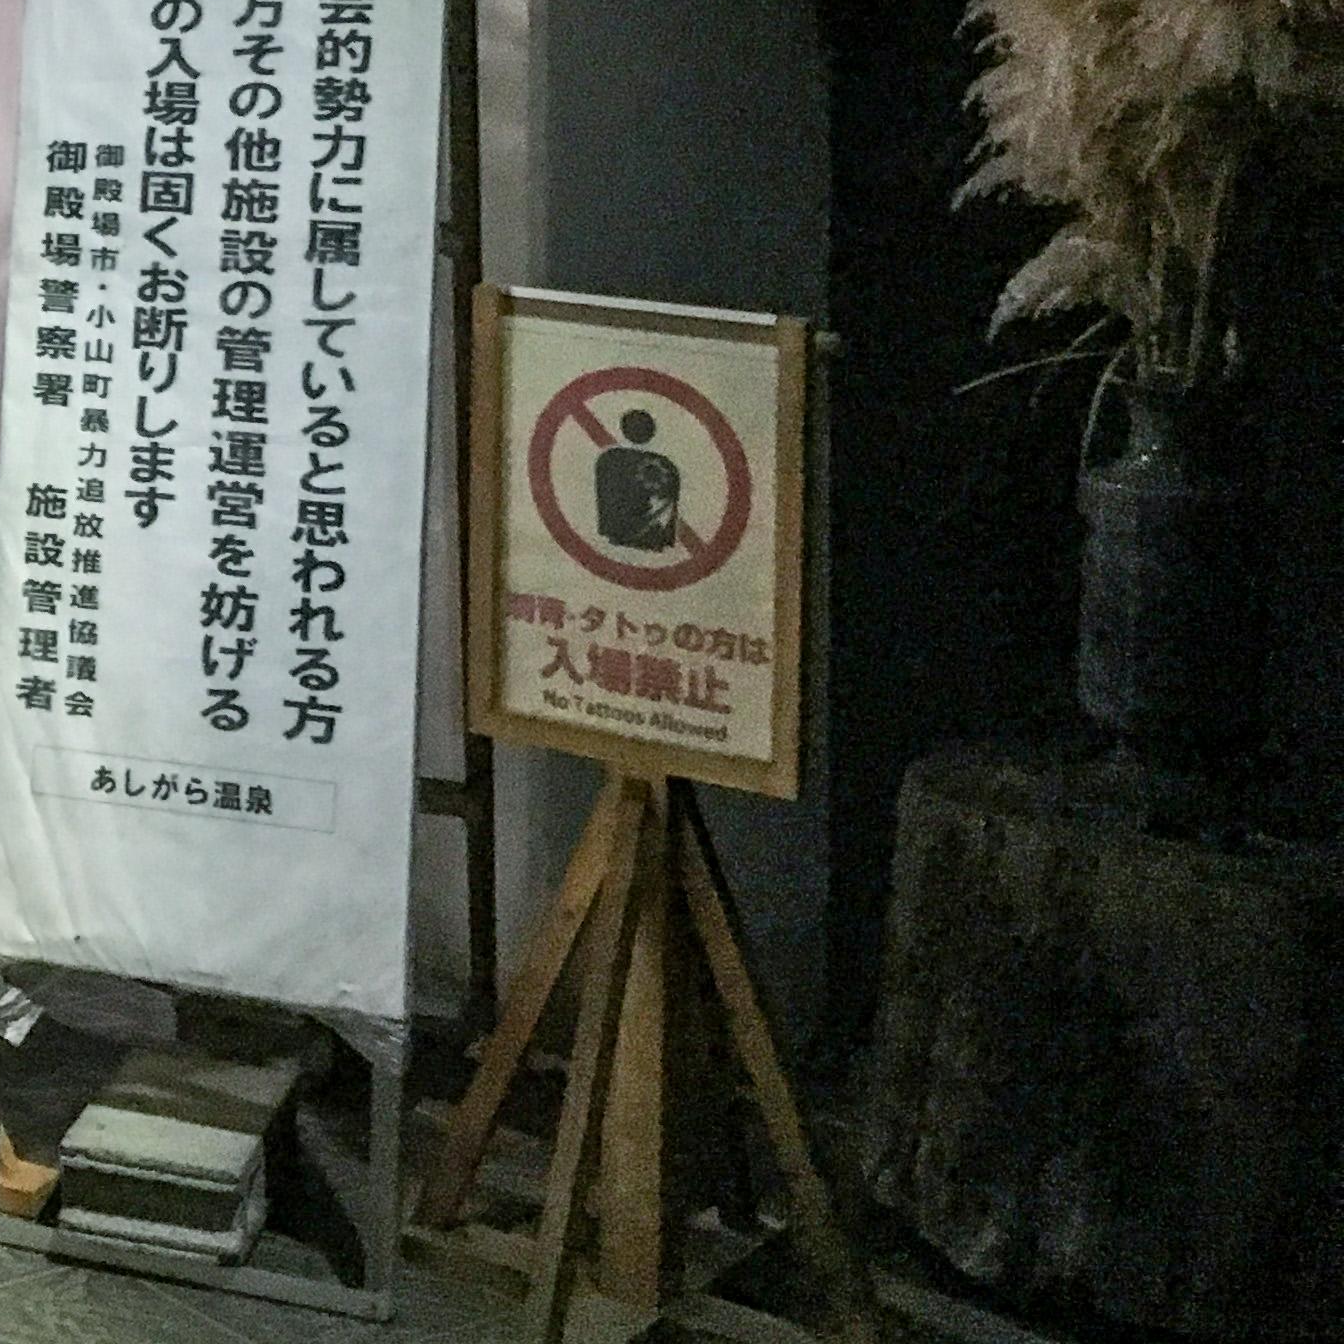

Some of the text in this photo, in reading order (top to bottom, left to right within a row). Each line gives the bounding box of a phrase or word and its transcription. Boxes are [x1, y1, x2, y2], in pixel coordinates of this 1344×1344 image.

[15, 140, 87, 712] 御殿場警察署 施設管理者
[64, 144, 127, 718] 御殿場市・小山町暴力追放推進協議会
[91, 766, 273, 815] あしがら温泉
